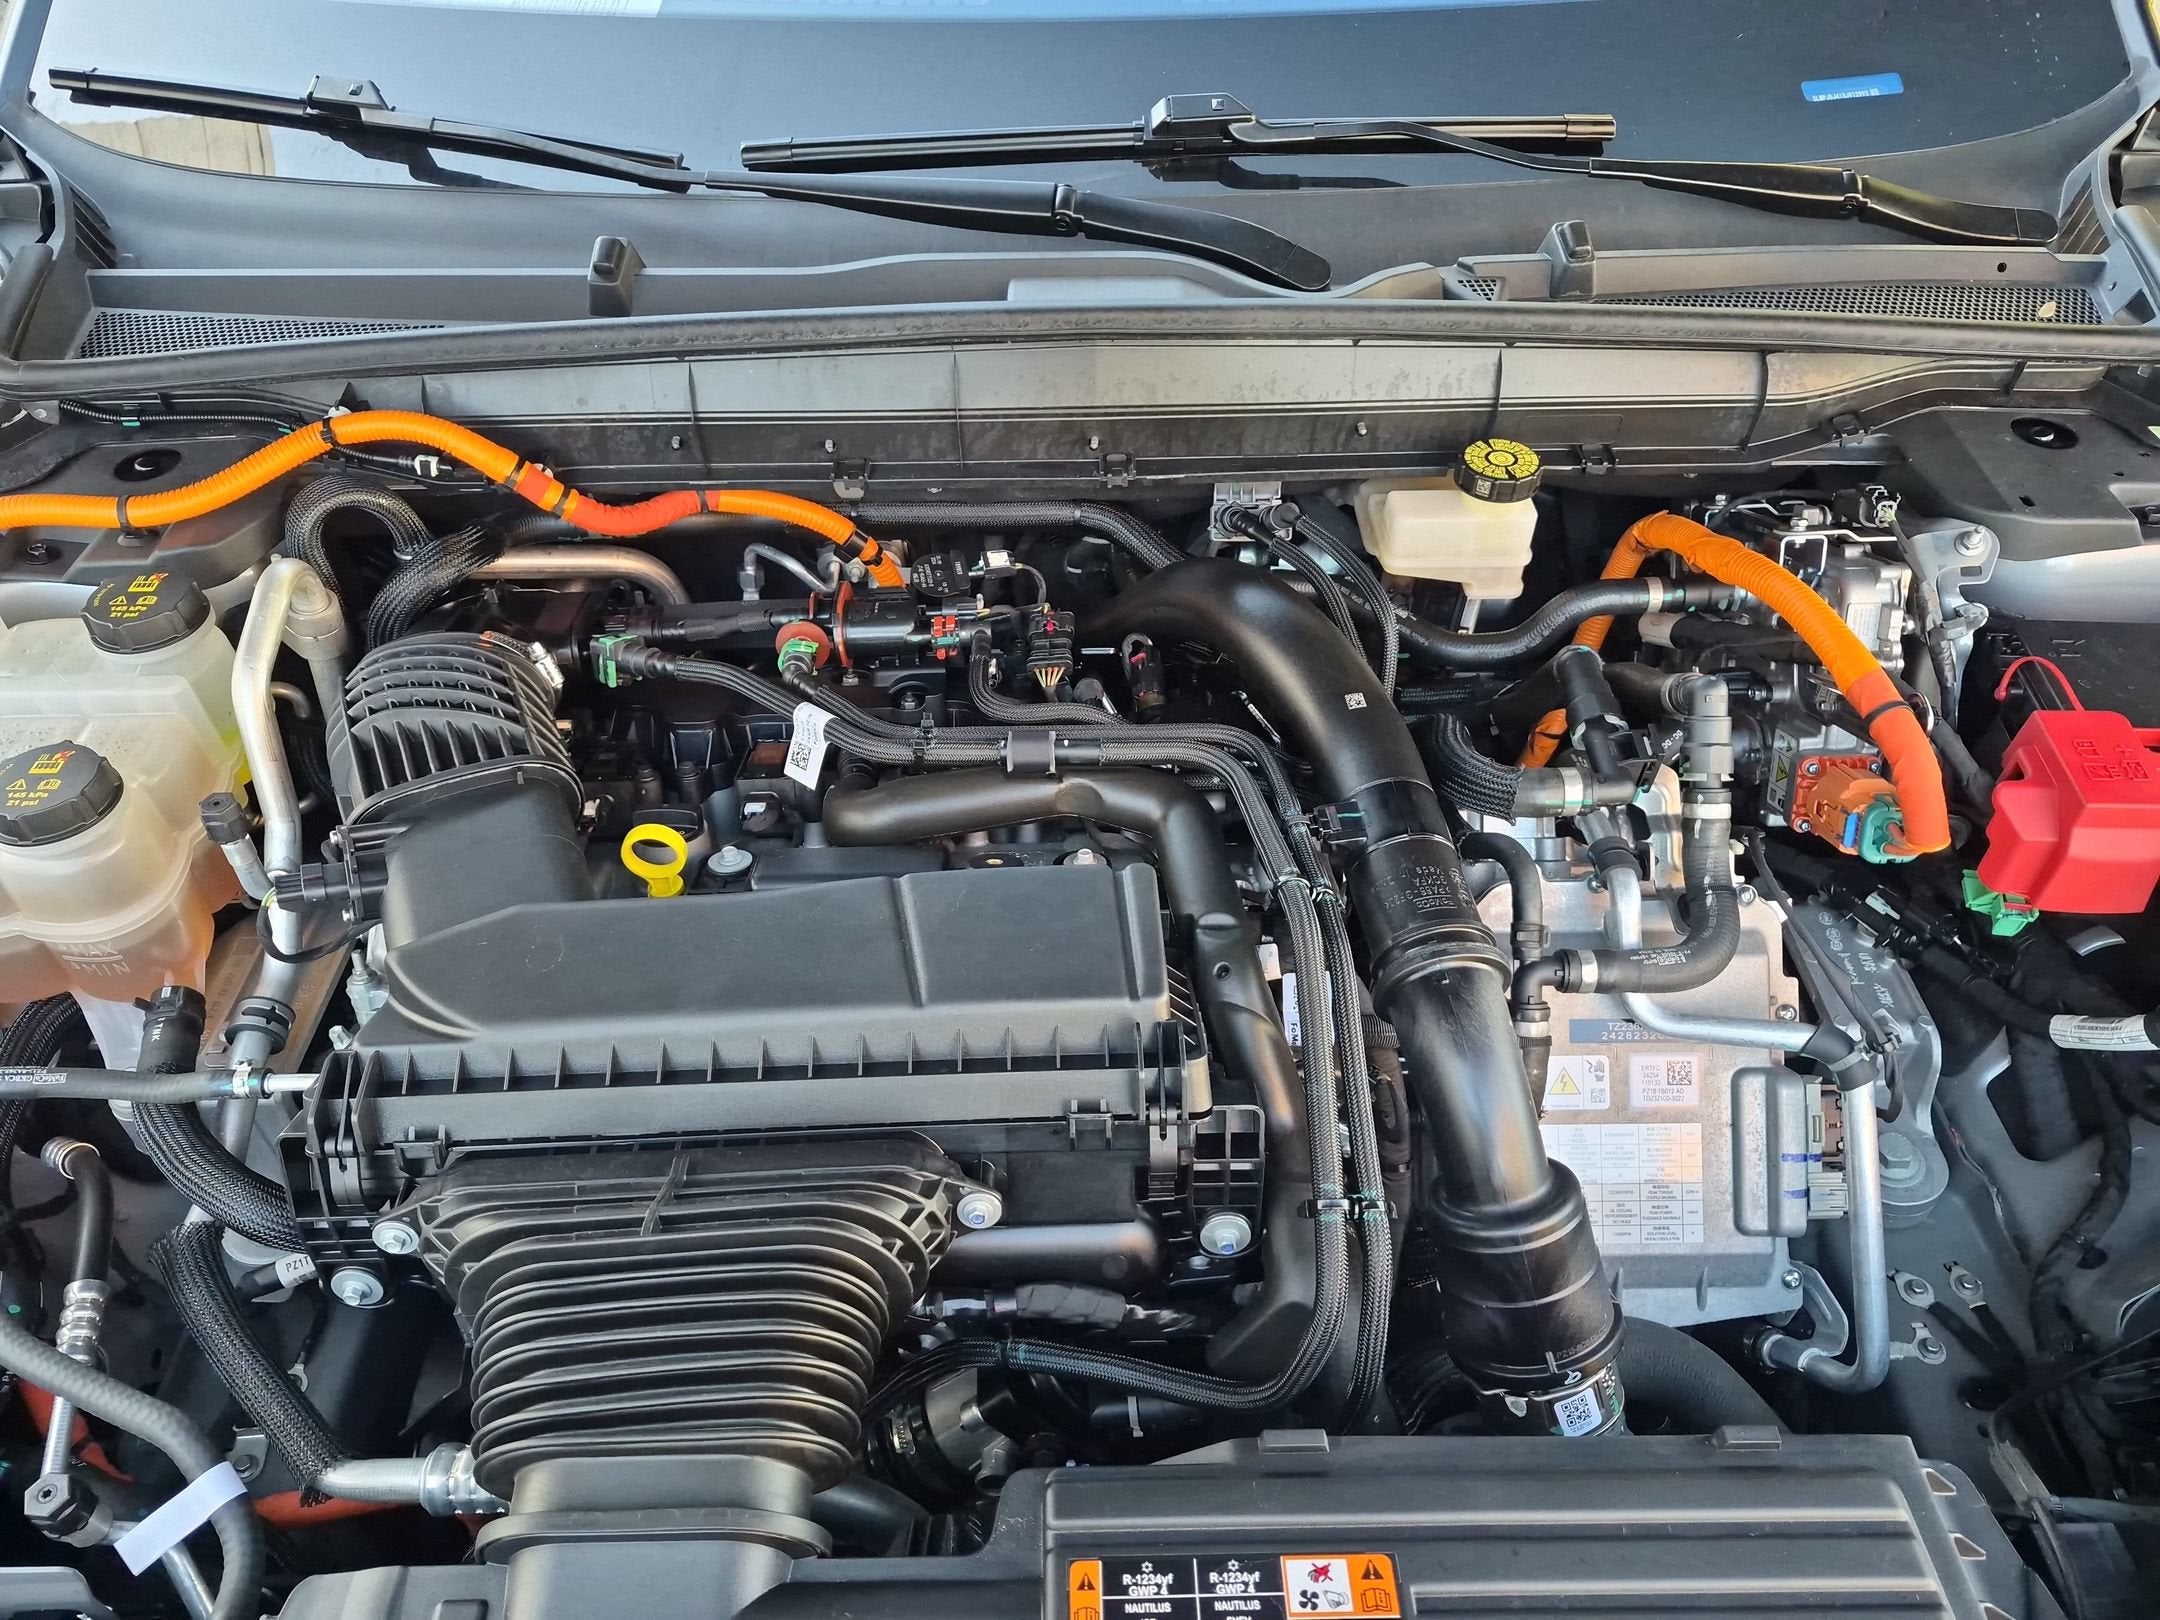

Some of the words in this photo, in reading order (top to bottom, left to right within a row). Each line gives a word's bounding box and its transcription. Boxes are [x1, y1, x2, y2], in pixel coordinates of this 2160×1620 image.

[21, 799, 40, 807] psi
[1607, 1022, 1644, 1031] TZ236
[285, 1255, 309, 1273] PZ1T
[1122, 1573, 1174, 1586] R-1234yf
[1209, 1571, 1261, 1584] R-1234yf
[1128, 1585, 1158, 1597] GWP
[1159, 1585, 1169, 1596] 4
[1215, 1583, 1246, 1595] GWP
[1247, 1582, 1256, 1594] 4
[1124, 1601, 1172, 1613] NAUTILUS
[1214, 1599, 1262, 1611] NAUTILUS
